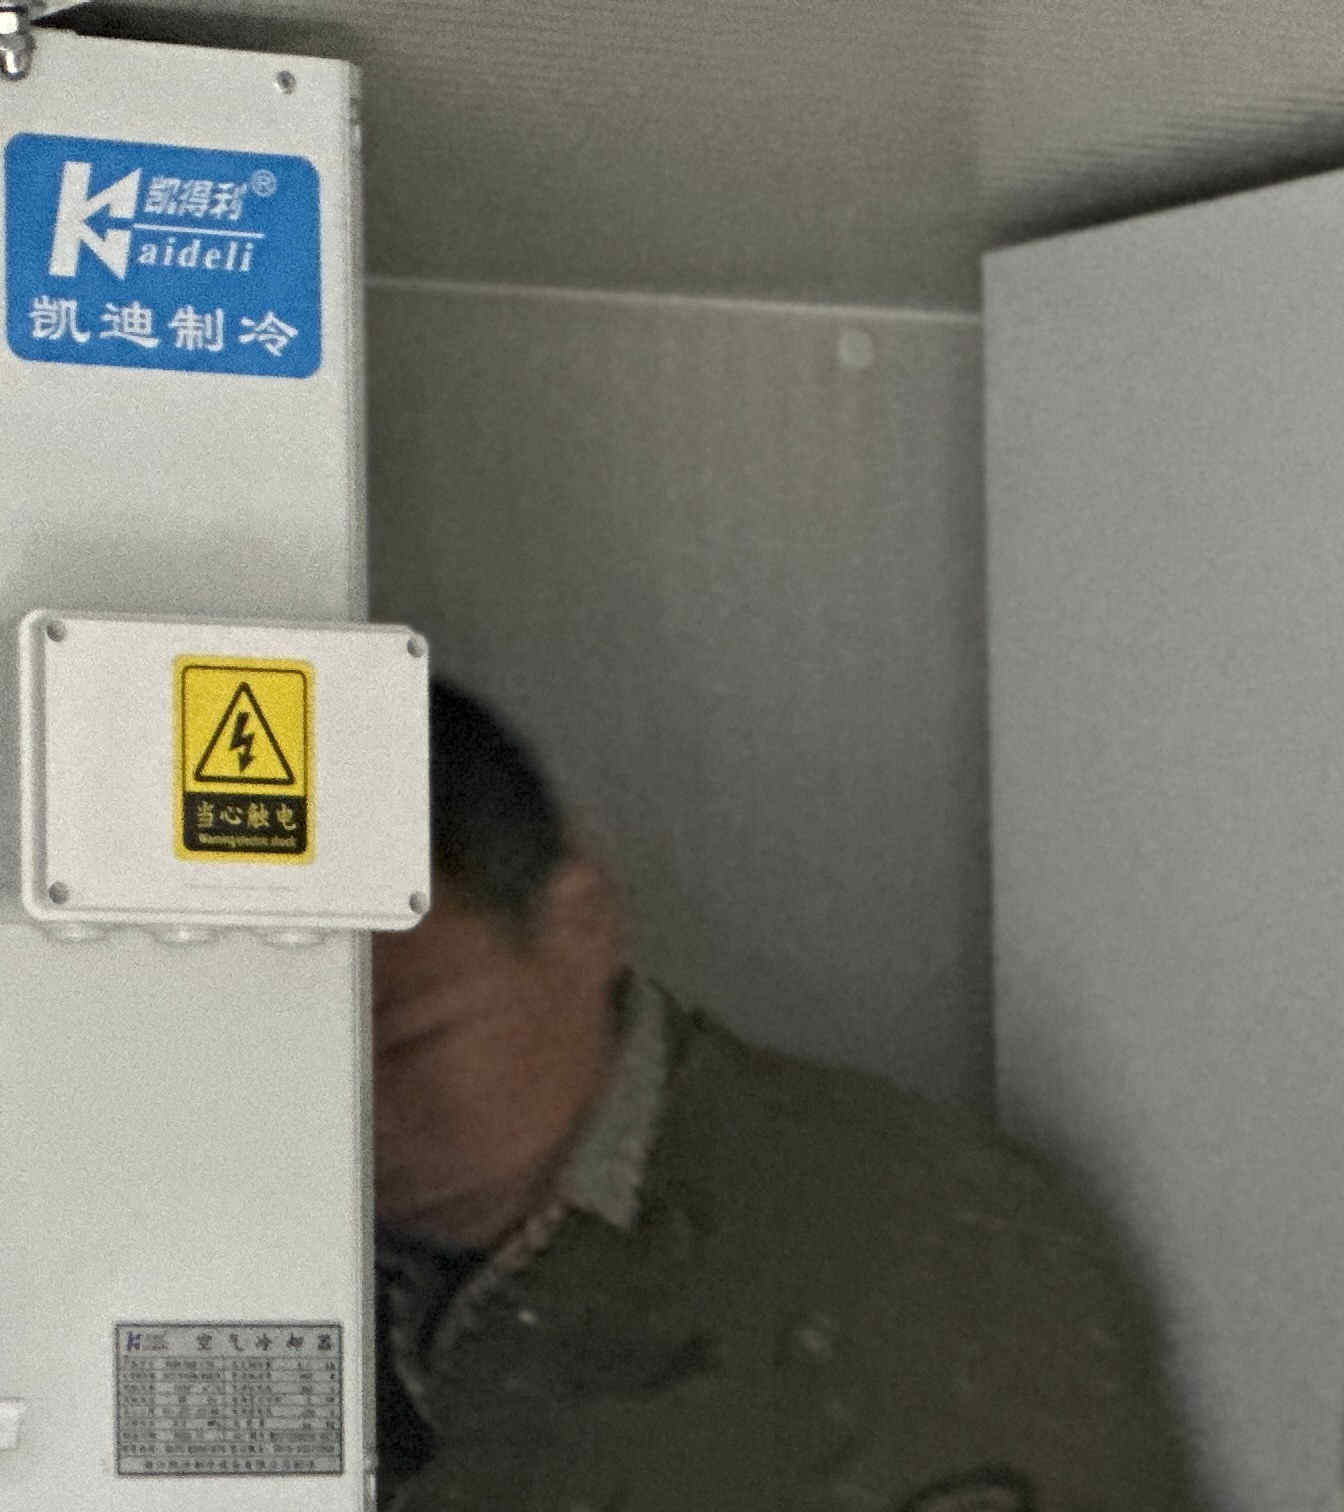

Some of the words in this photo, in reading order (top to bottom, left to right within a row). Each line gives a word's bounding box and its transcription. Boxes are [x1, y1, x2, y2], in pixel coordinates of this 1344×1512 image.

[28, 294, 299, 358] 凯迪制冷
[196, 800, 297, 831] 当心触电
